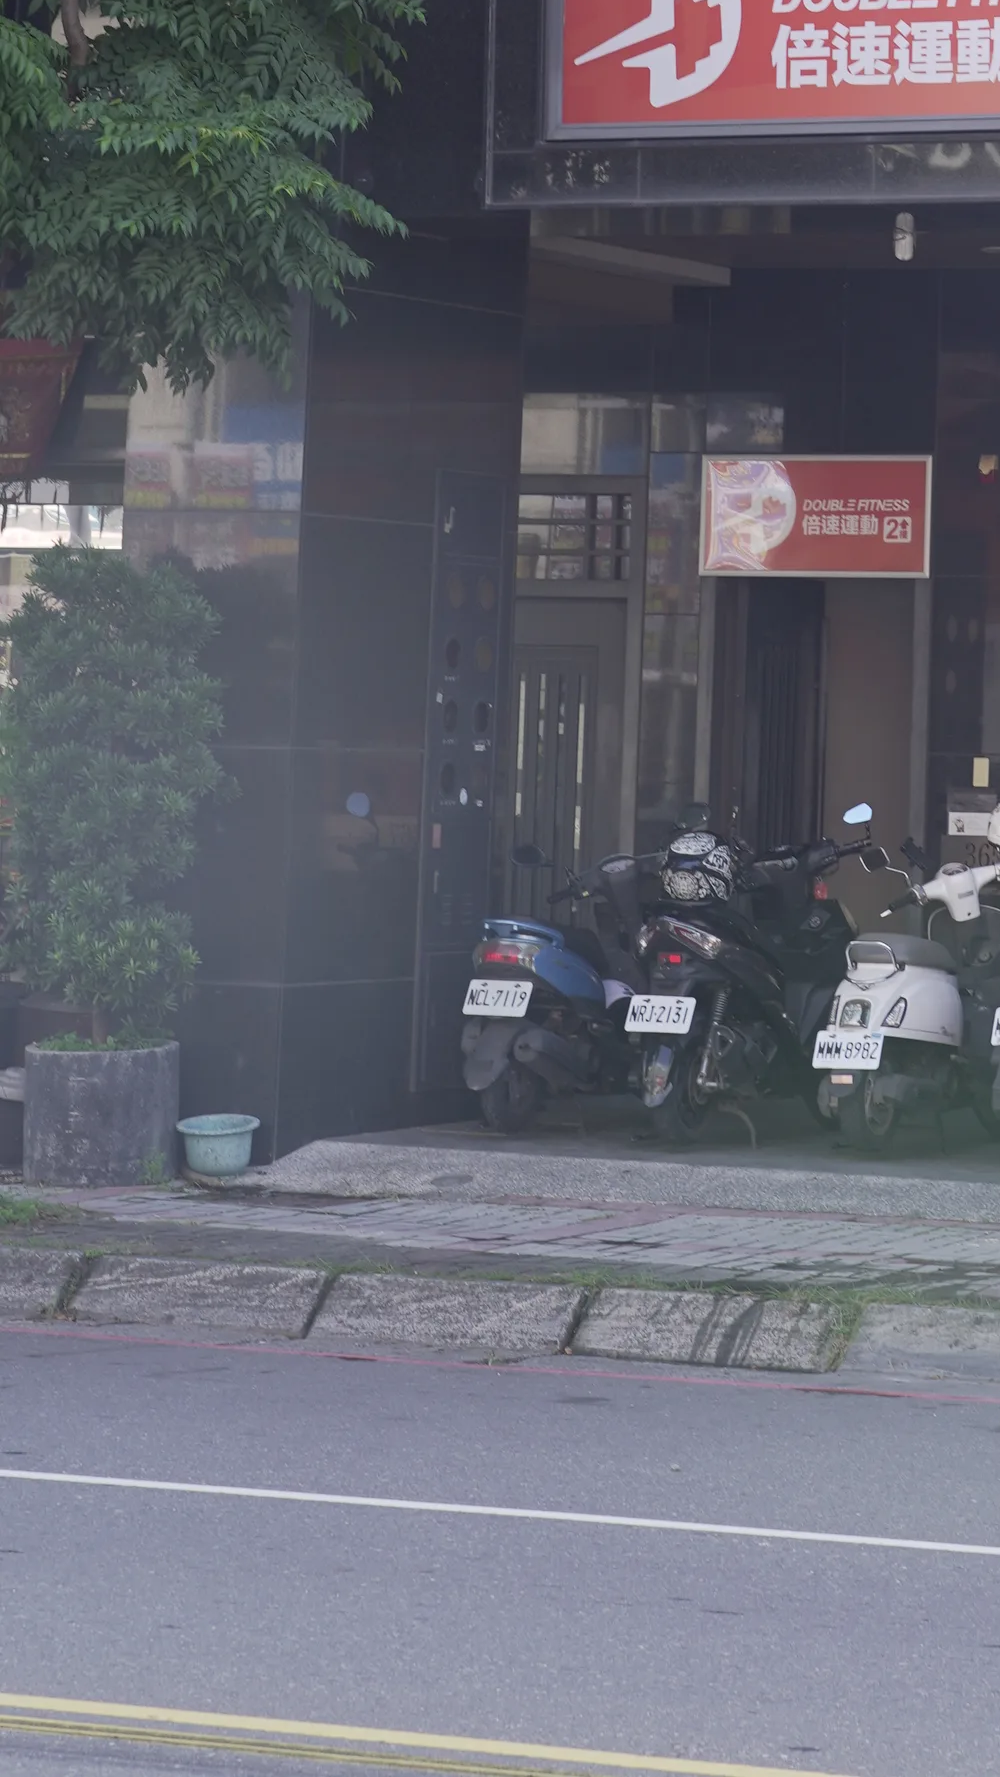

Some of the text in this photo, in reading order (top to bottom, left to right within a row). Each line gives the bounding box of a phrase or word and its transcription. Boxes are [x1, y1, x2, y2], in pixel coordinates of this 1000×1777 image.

[802, 498, 910, 512] DOUBLE FITNESS
[801, 514, 879, 536] 倍速運動
